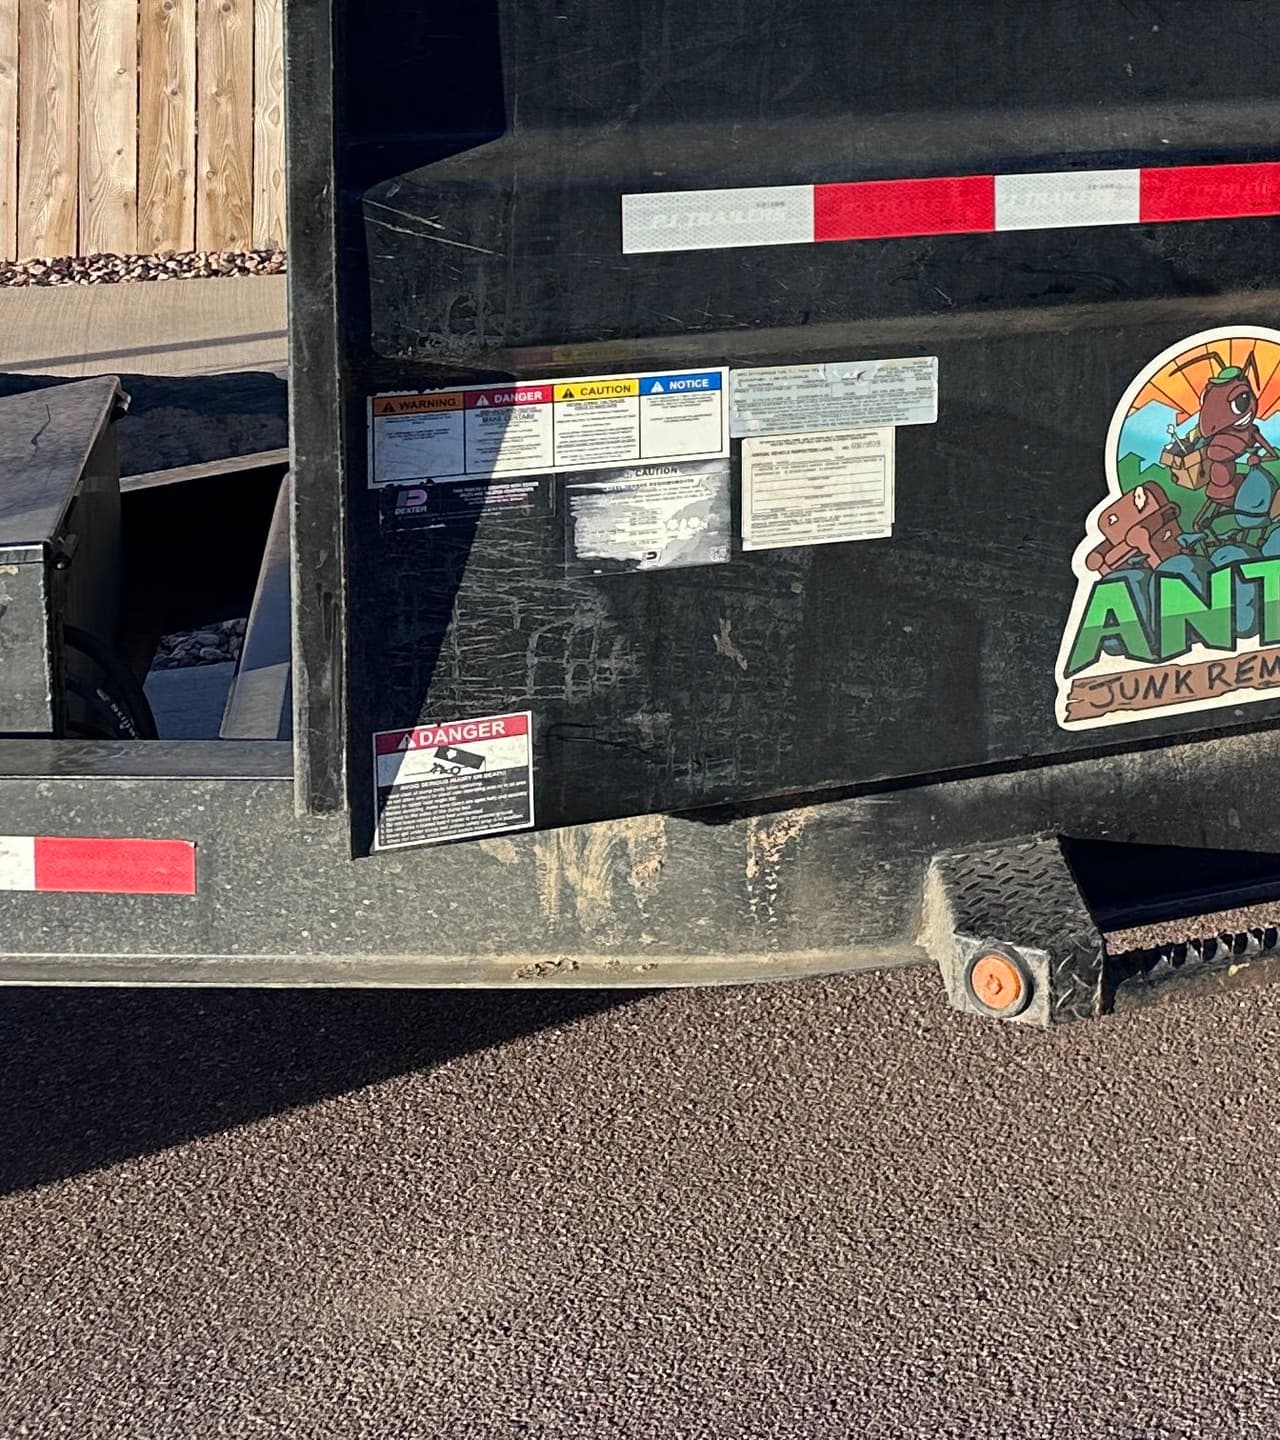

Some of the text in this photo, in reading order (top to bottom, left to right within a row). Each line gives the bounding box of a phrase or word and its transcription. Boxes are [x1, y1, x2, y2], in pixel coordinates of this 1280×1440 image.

[580, 384, 632, 397] CAUTION
[669, 378, 710, 391] NOTICE
[398, 397, 457, 411] WARNING
[493, 391, 544, 404] DANGER
[634, 466, 680, 479] CAUTION
[393, 505, 428, 515] DEXTER
[1088, 670, 1196, 709] JUNK
[418, 720, 507, 747] DANGER
